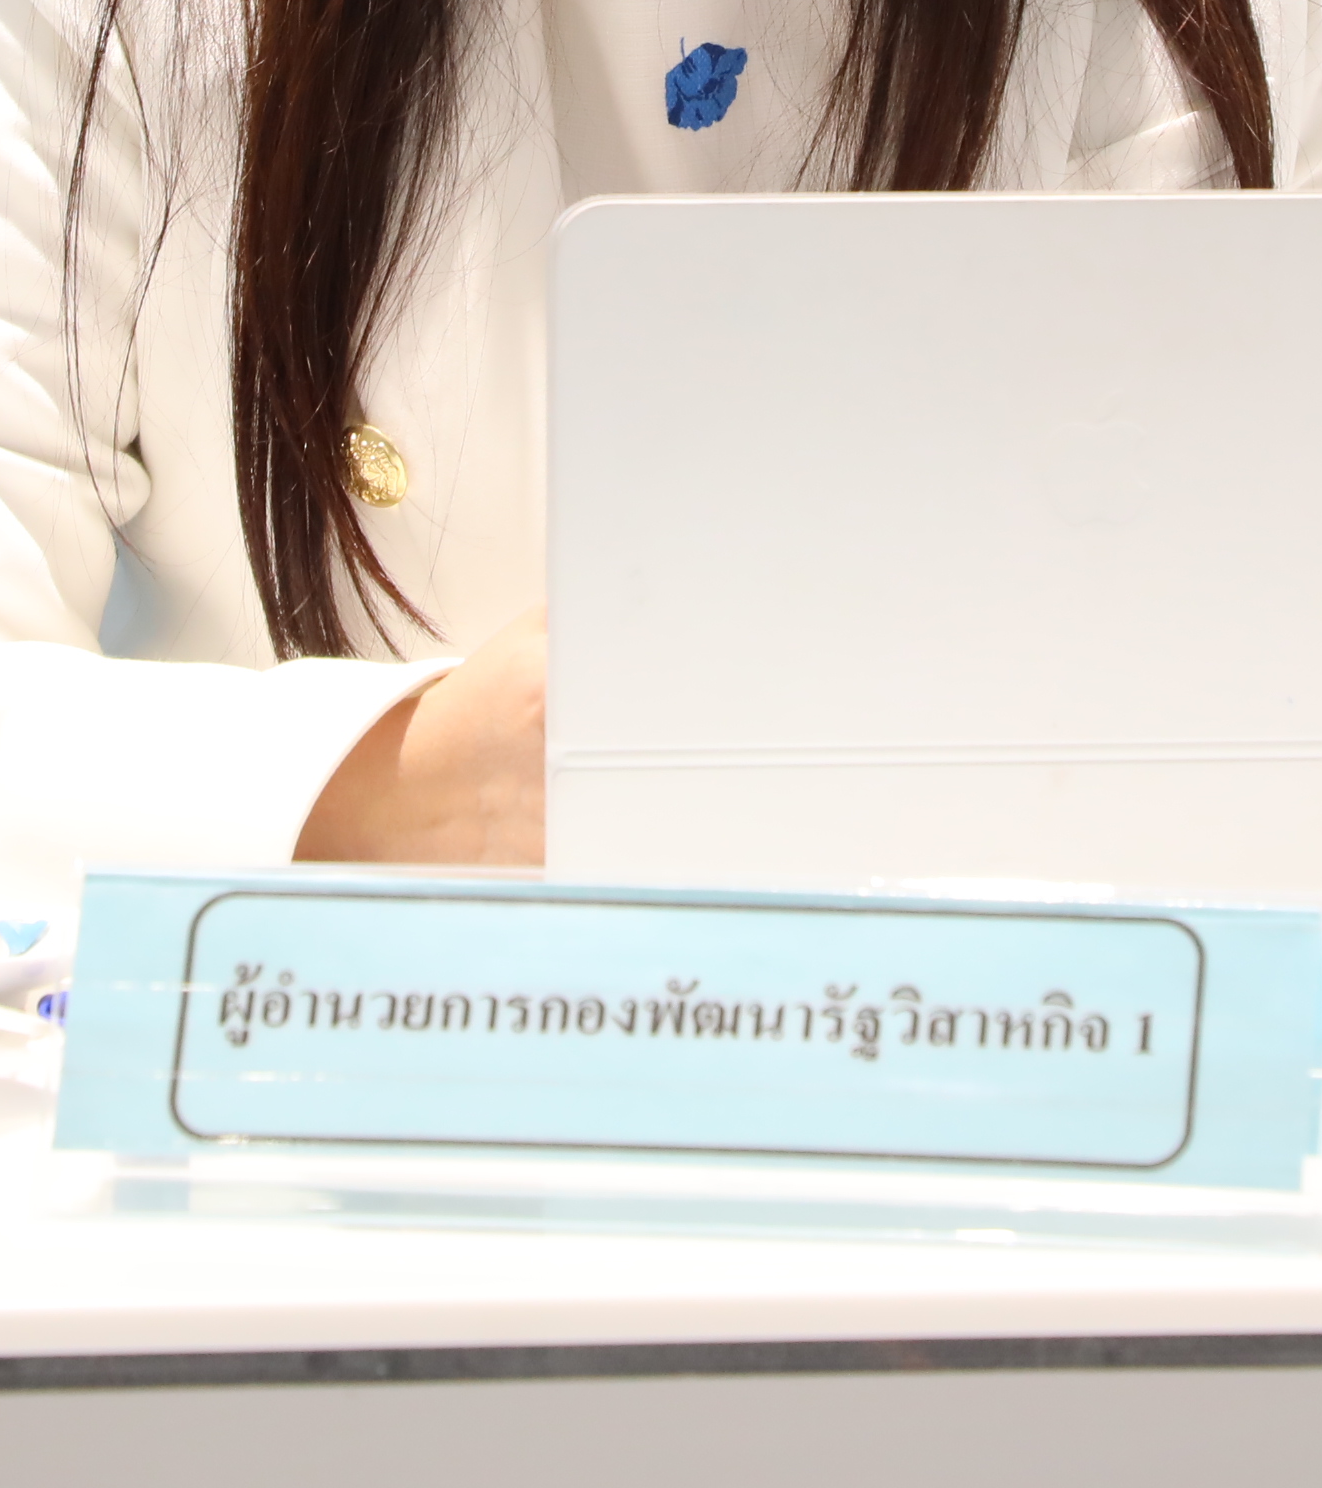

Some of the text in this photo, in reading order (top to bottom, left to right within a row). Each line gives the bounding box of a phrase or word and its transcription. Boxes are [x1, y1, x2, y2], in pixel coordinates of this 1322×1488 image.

[218, 962, 1154, 1061] ผู้อำนวยการกองพัฒนารัฐวิสาหกิจ 1
